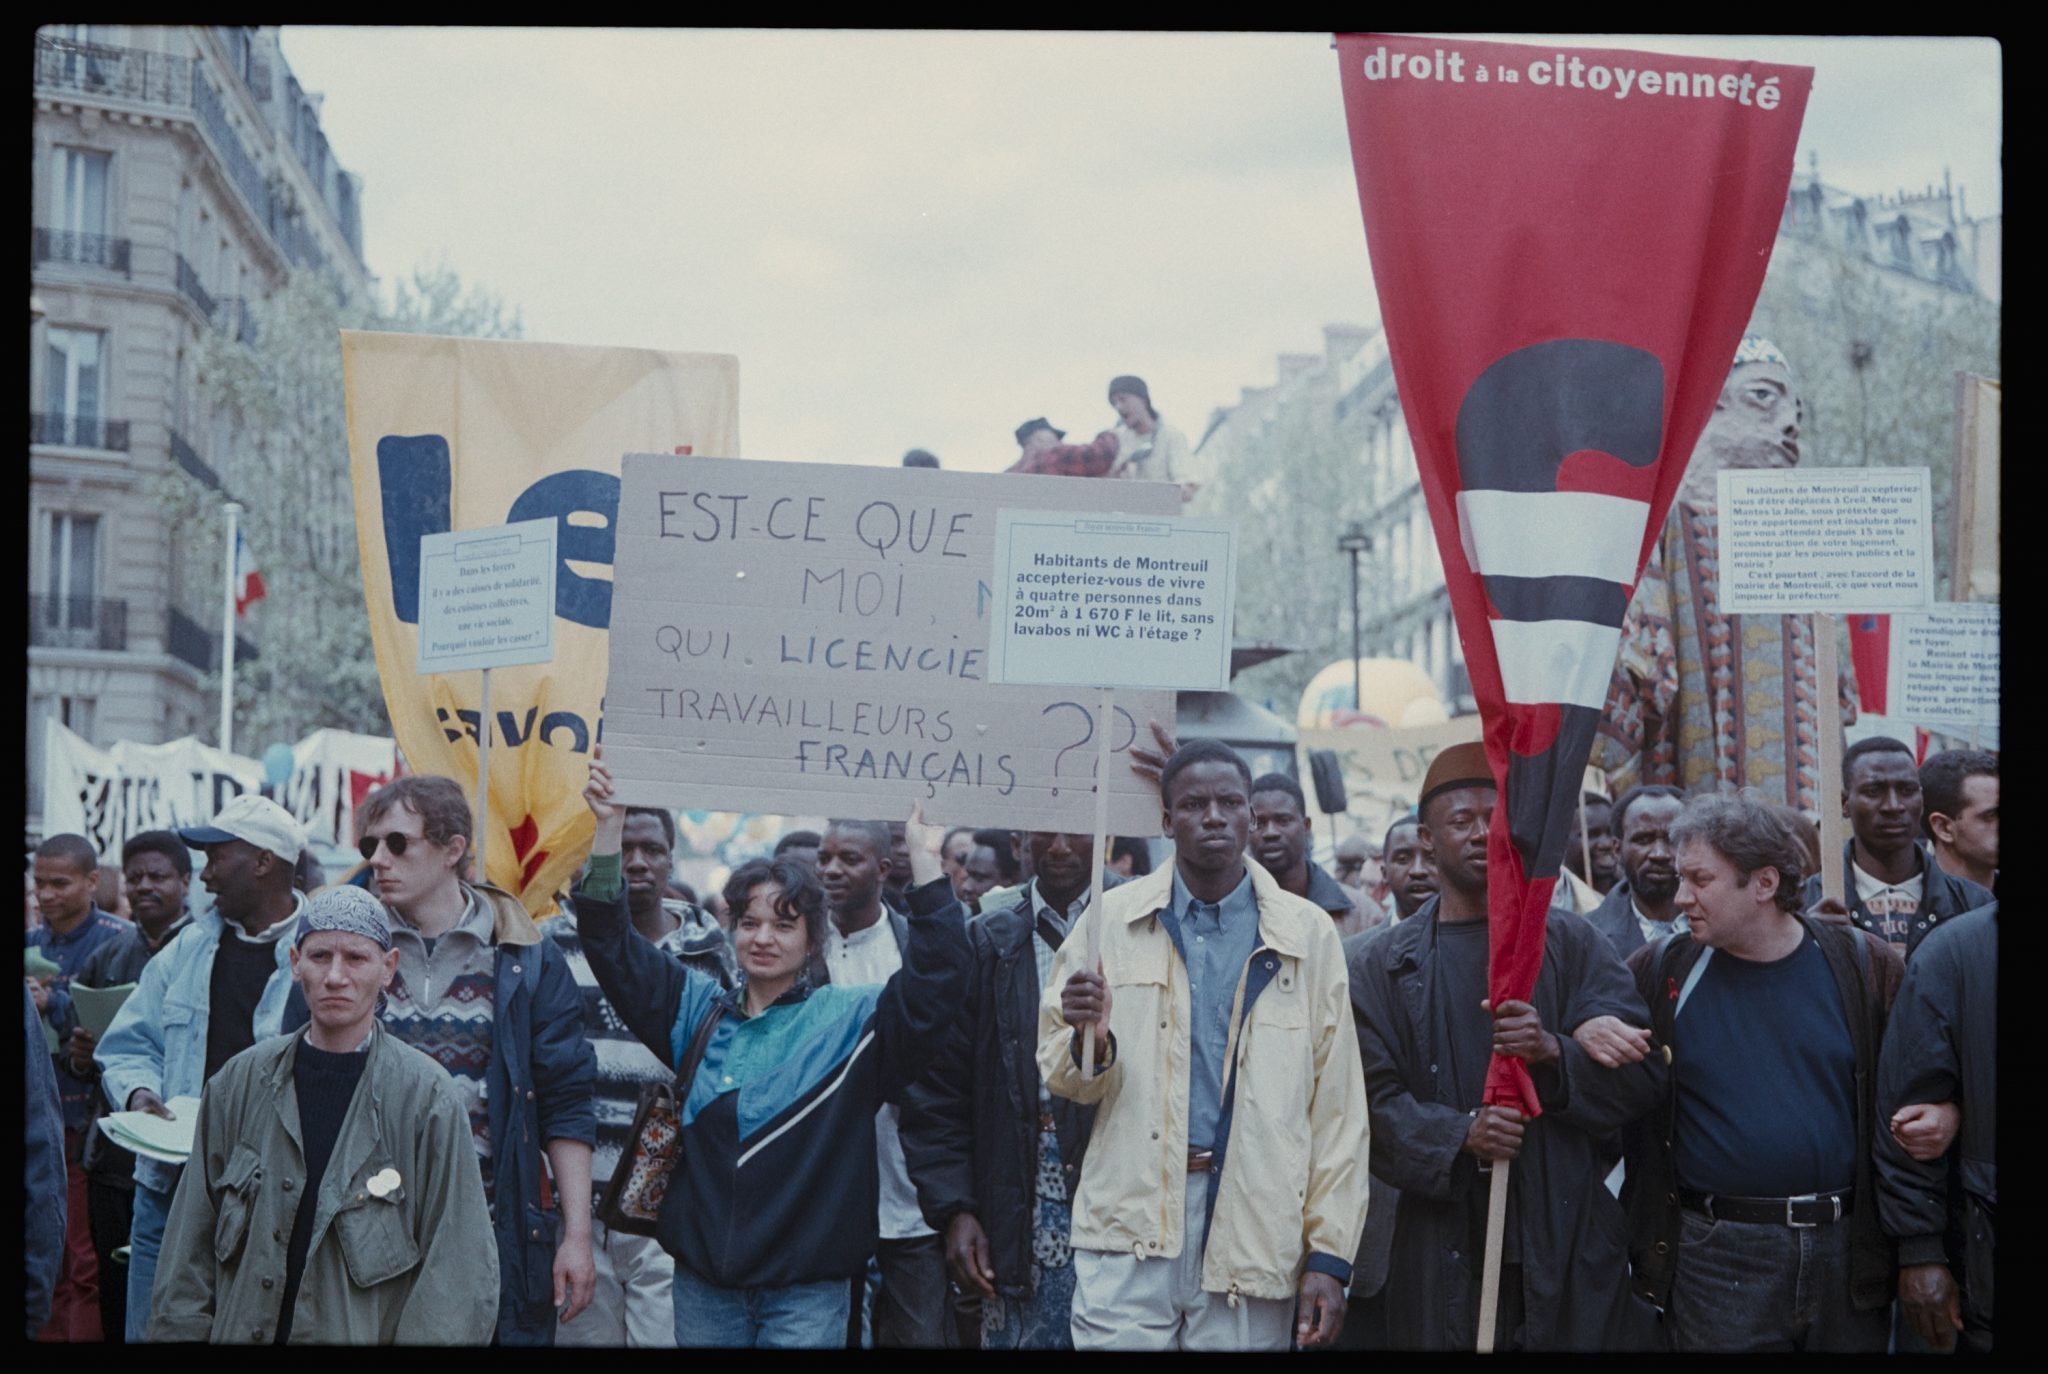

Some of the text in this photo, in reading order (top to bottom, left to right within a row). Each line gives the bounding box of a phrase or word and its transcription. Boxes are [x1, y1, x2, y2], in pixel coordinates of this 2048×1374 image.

[1364, 47, 1781, 110] droit à la citoyenneté
[1746, 486, 1794, 495] Habitants
[1796, 486, 1808, 494] de
[1812, 486, 1858, 494] Montreuil
[1788, 496, 1830, 506] déplacés
[1834, 496, 1840, 504] à
[1872, 495, 1897, 504] Méru
[1733, 508, 1770, 516] Mantes
[1772, 508, 1781, 516] la
[1836, 506, 1878, 516] prétexte
[1880, 508, 1898, 516] que
[659, 490, 974, 560] EST-CE QUE
[1761, 518, 1822, 528] appartement
[1827, 518, 1841, 526] est
[1845, 516, 1890, 526] insalubre
[1893, 516, 1917, 525] alors
[1733, 530, 1751, 538] que
[1779, 528, 1822, 537] attendez
[1824, 528, 1856, 537] depuis
[1861, 527, 1872, 536] 15
[1896, 528, 1904, 536] la
[1733, 540, 1804, 548] reconstruction
[1734, 548, 1916, 559] promise par les pouvoirs publics et la
[1034, 553, 1208, 572] Habitants de Montreuil
[1734, 560, 1765, 568] mairie
[460, 568, 479, 577] Dans
[480, 564, 490, 573] les
[1776, 570, 1818, 580] pourtant
[1892, 570, 1904, 578] de
[1906, 570, 1916, 578] la
[1016, 572, 1206, 590] accepteriez-vous de vivre
[1734, 582, 1765, 590] mairie
[1768, 582, 1780, 590] de
[1850, 582, 1868, 590] que
[1871, 581, 1893, 589] veut
[452, 586, 465, 596] des
[493, 582, 504, 591] de
[1016, 587, 1202, 607] à quatre personnes dans
[1734, 592, 1773, 601] imposer
[1776, 592, 1786, 600] la
[443, 606, 456, 615] des
[1060, 606, 1068, 619] à
[1124, 609, 1134, 621] F
[1138, 610, 1151, 622] le
[1156, 610, 1175, 624] lit,
[1180, 612, 1214, 624] sans
[1928, 614, 1954, 624] Nous
[458, 623, 471, 631] une
[474, 620, 484, 628] vie
[1014, 622, 1202, 642] lavabos ni WC à l'étage ?
[432, 639, 467, 652] Pourquoi
[468, 636, 496, 648] vouloir
[497, 634, 508, 643] les
[510, 632, 533, 642] casser
[655, 625, 984, 681] QUI LICENCIE
[1908, 660, 1918, 668] la
[1921, 660, 1954, 670] Mairie
[1957, 661, 1968, 670] de
[1908, 672, 1932, 680] nous
[645, 688, 954, 743] TRAVAILLEURS
[1906, 706, 1920, 714] vie
[795, 740, 1016, 799] FRANÇAIS
